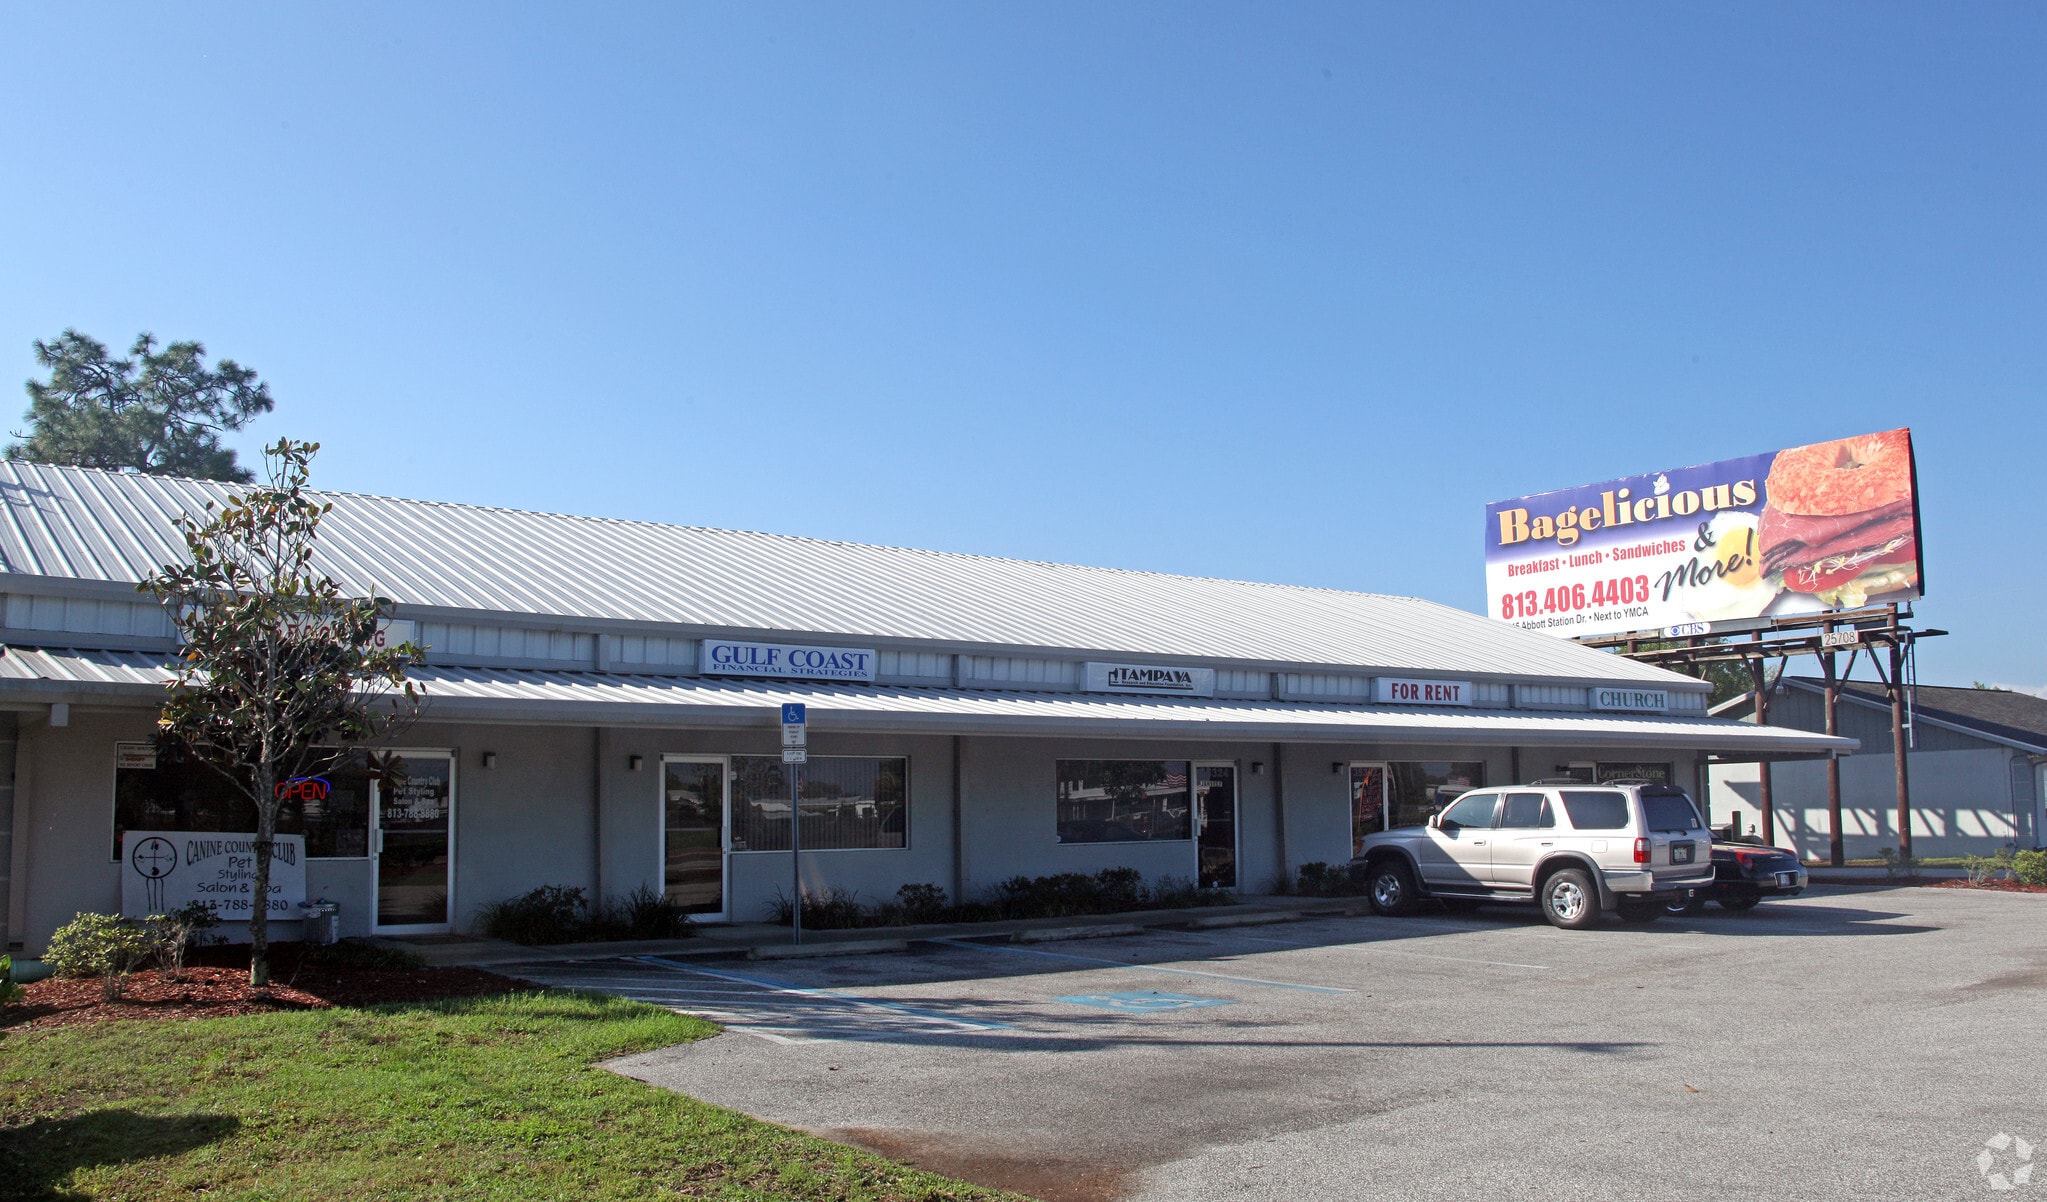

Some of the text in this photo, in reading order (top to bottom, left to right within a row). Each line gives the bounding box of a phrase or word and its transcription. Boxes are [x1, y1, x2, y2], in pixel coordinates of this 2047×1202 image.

[1496, 478, 1757, 546] Bagelicious
[1693, 521, 1717, 553] &
[1507, 539, 1686, 578] Breakfast Lunch Sandwiches
[1654, 527, 1754, 602] More!
[1501, 575, 1650, 620] 813.406.4403
[1521, 619, 1546, 630] Abbott
[1547, 614, 1575, 628] Station
[1576, 612, 1588, 624] Dr.
[1593, 610, 1612, 622] Next
[1613, 610, 1622, 619] to
[1623, 606, 1649, 618] YMCA
[1681, 622, 1704, 635] CBS
[1824, 632, 1856, 646] 25708
[711, 645, 870, 671] GULF COAST
[713, 663, 868, 677] FINANCIAL STRATEGIES
[1391, 683, 1460, 701] FOR RENT
[1600, 691, 1665, 708] CHURCH
[274, 782, 326, 800] OPEN
[393, 787, 435, 797] Pet Styling
[393, 797, 413, 805] Salon
[186, 840, 223, 867] CANINE
[272, 842, 296, 867] CLUB
[228, 856, 253, 868] Pet
[197, 882, 237, 894] Salon
[240, 883, 249, 893] &
